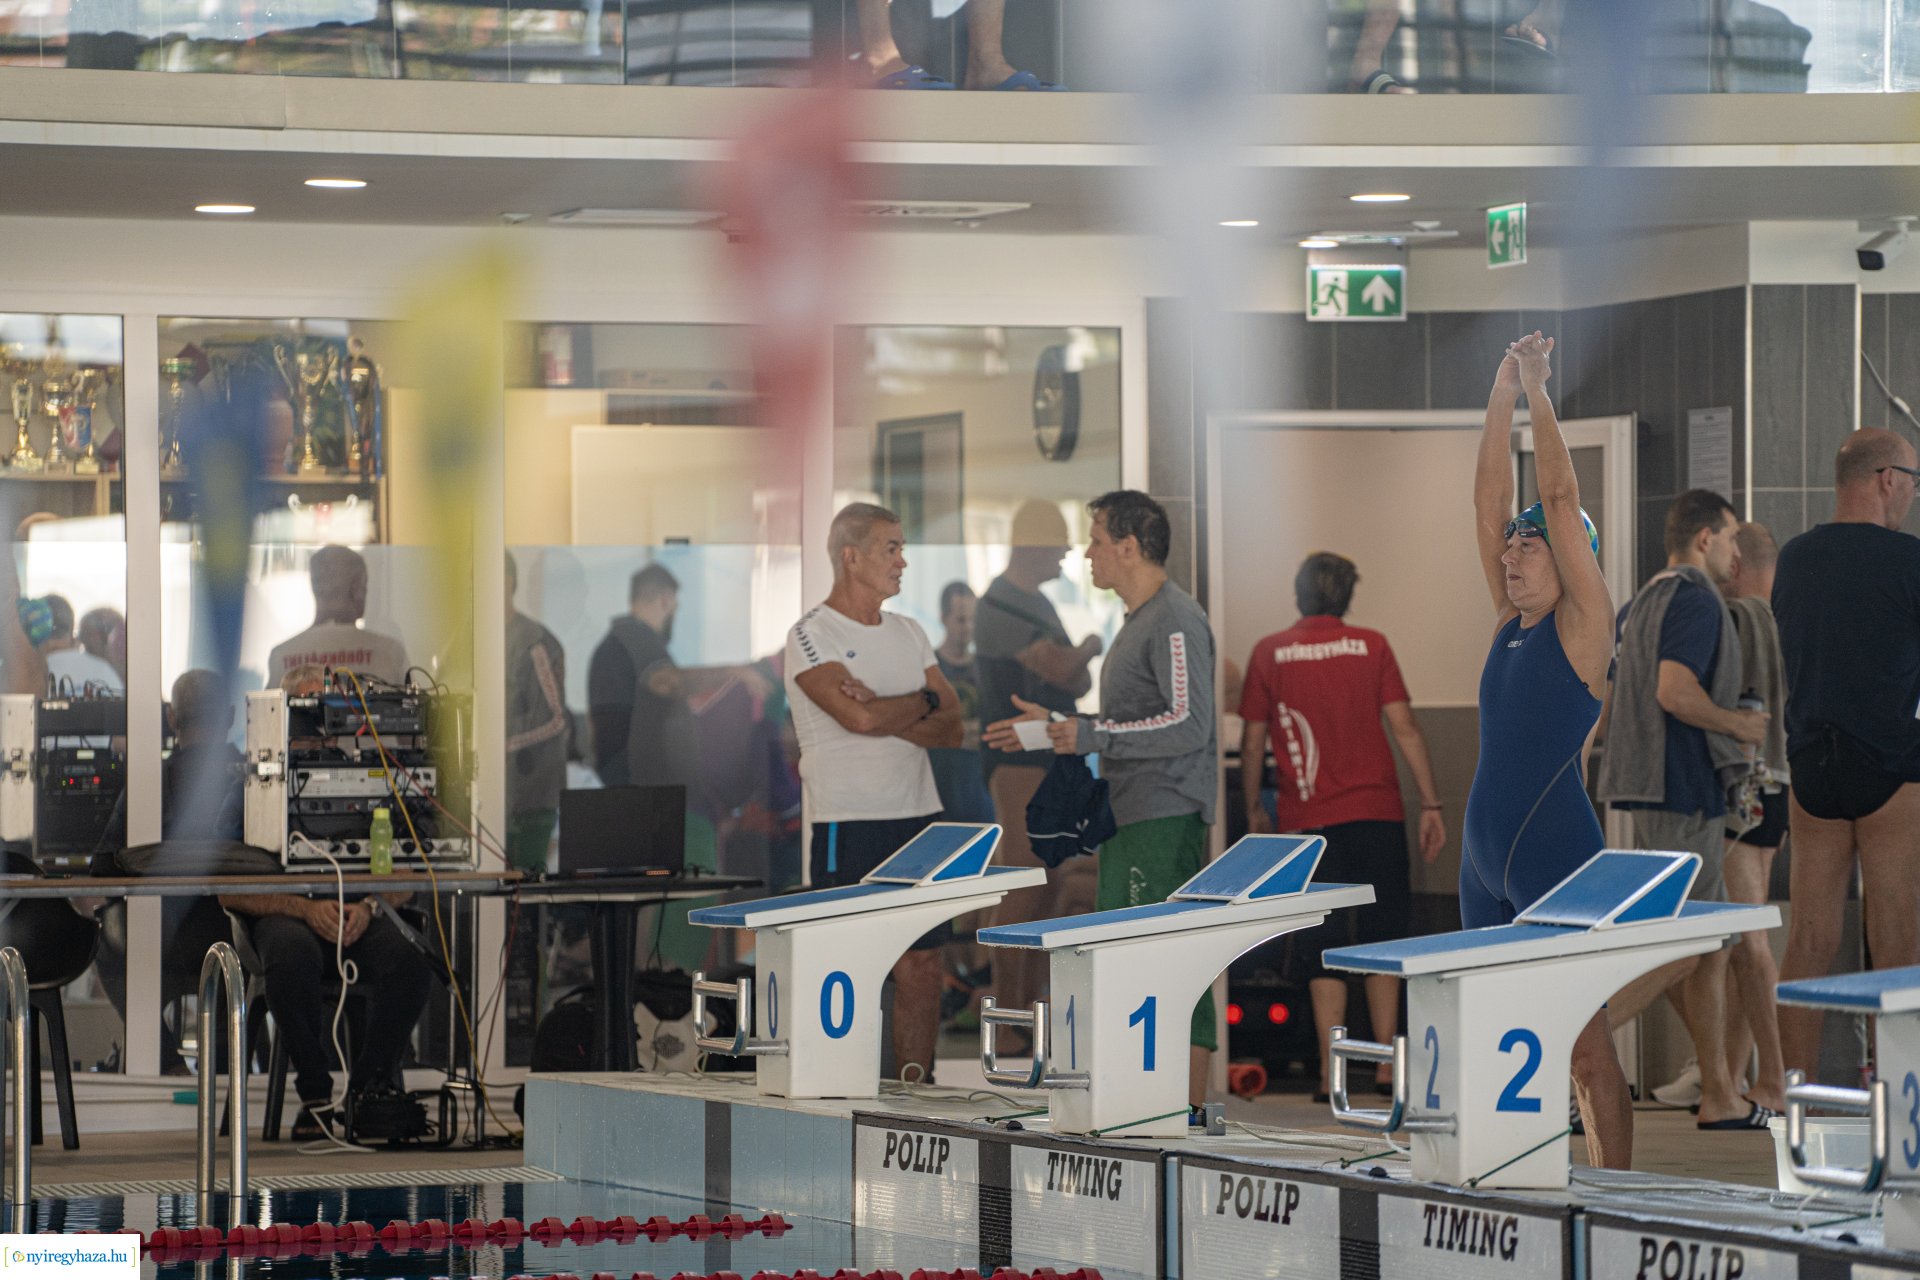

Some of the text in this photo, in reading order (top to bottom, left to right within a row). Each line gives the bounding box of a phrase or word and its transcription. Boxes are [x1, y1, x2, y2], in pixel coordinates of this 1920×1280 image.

[1275, 636, 1368, 664] NYÍREGYHÁZA
[820, 971, 855, 1039] 0
[1066, 994, 1075, 1070] 1
[1129, 996, 1156, 1071] 1
[1424, 1025, 1440, 1110] 2
[1496, 1028, 1542, 1113] 2
[1903, 1071, 1920, 1169] 3
[883, 1131, 950, 1175] POLIP
[1047, 1151, 1122, 1201] TIMING
[1216, 1174, 1300, 1225] POLIP
[1423, 1203, 1519, 1262] TIMING
[1638, 1237, 1744, 1280] POLIP
